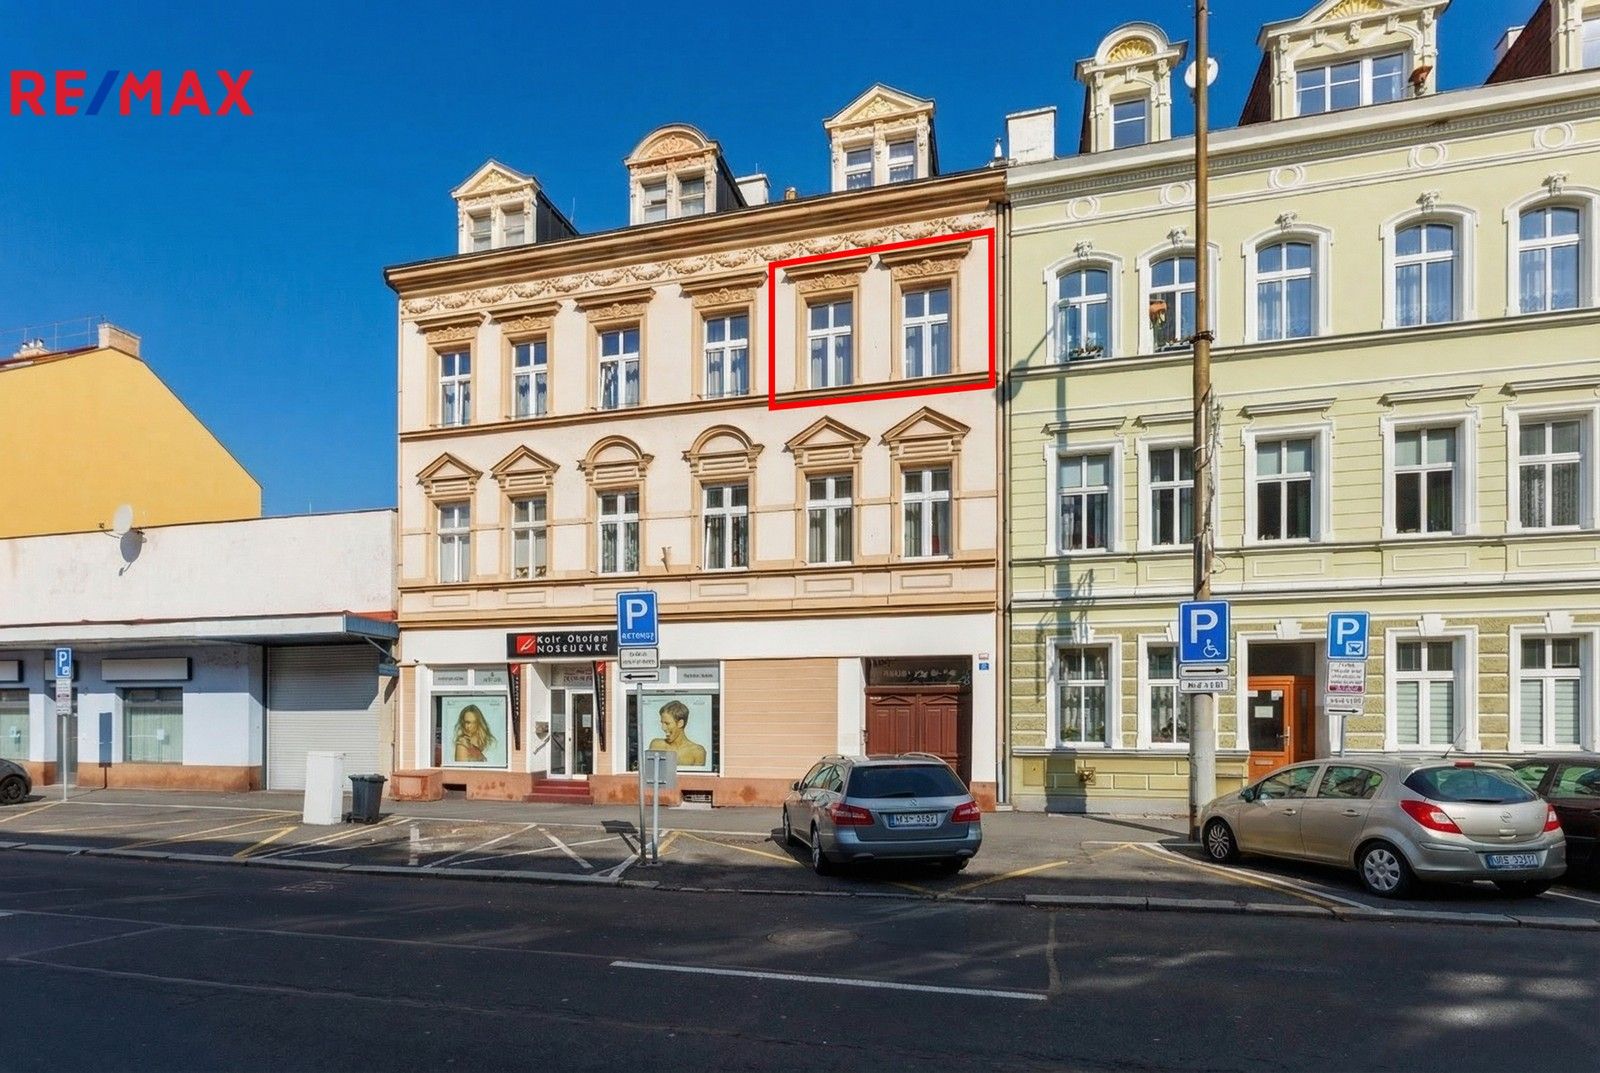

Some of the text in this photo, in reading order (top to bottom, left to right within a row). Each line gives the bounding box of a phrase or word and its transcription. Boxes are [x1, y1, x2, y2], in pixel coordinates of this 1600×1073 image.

[625, 599, 648, 630] P
[1190, 609, 1218, 644] P
[1336, 617, 1360, 645] P
[58, 651, 67, 668] P
